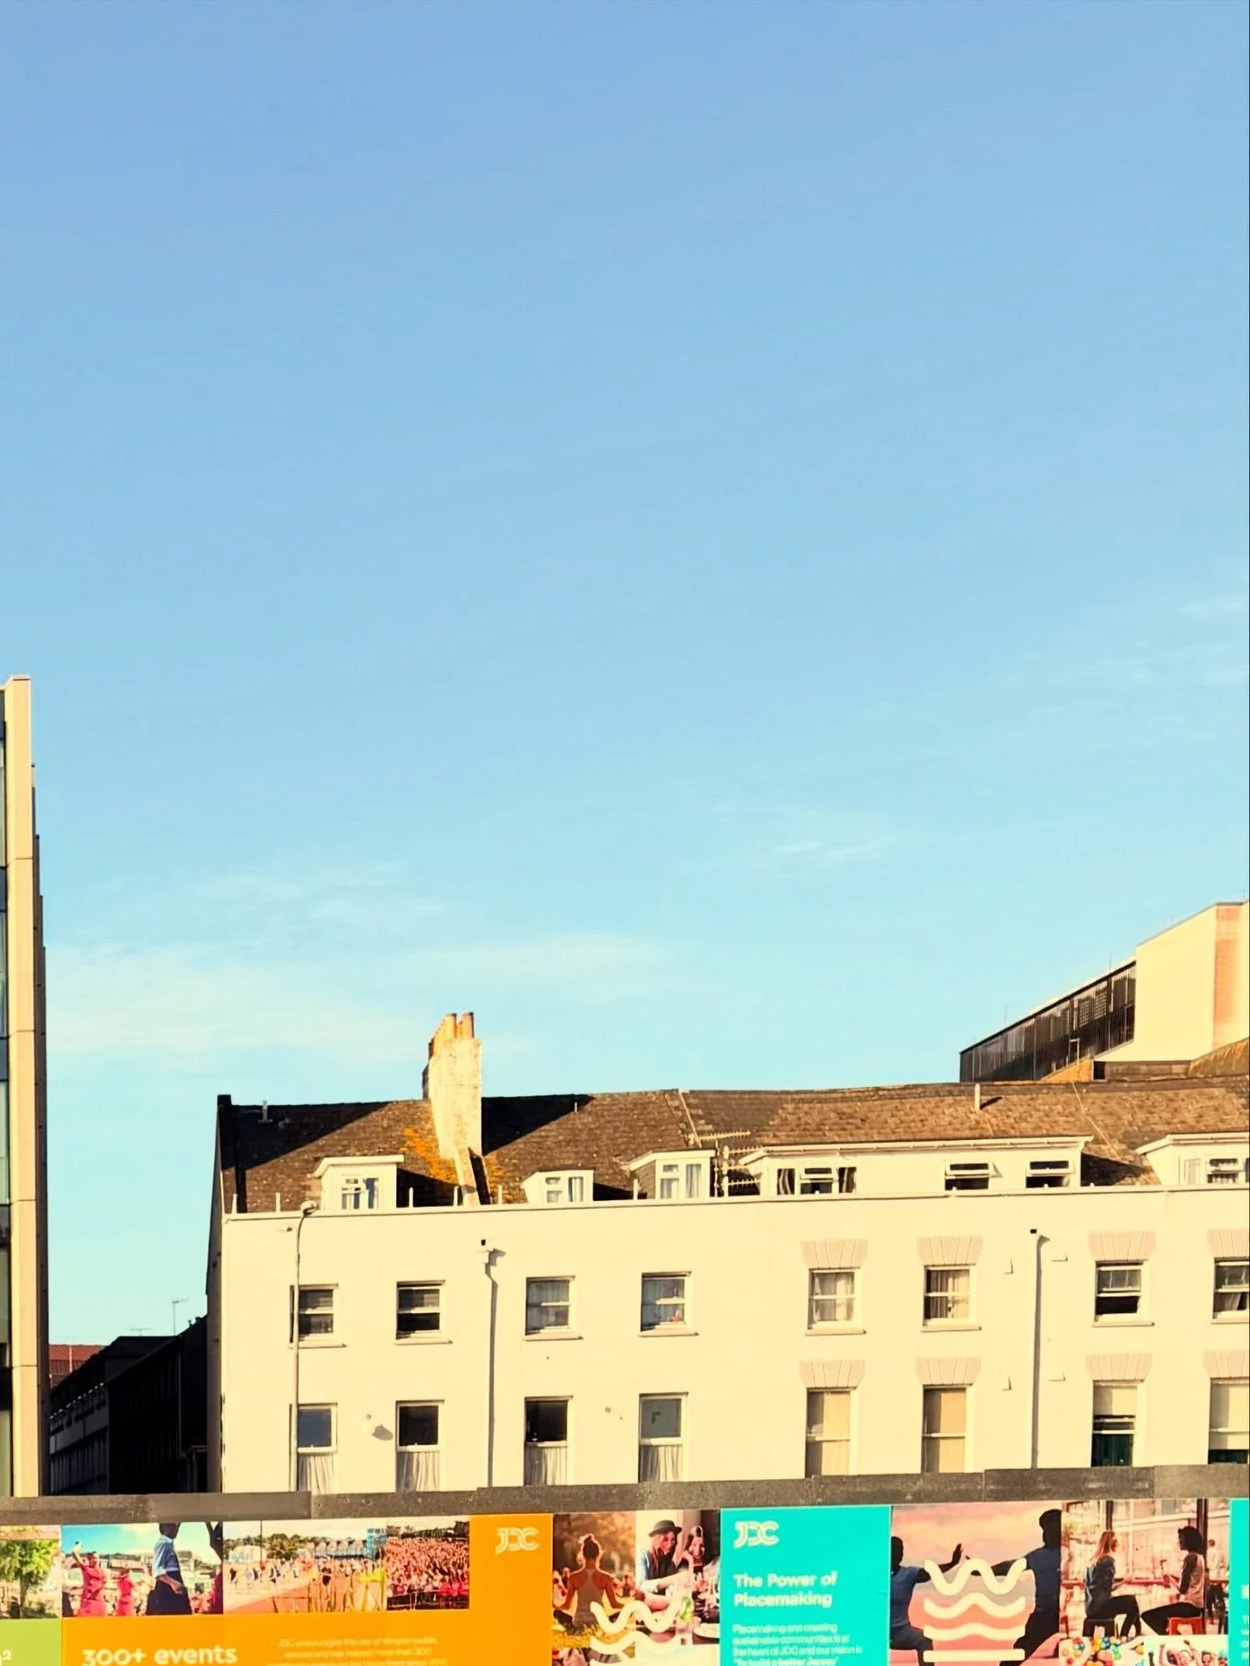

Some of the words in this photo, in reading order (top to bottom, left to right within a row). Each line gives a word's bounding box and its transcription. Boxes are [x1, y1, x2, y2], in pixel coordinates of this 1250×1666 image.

[494, 1526, 539, 1555] JDC
[733, 1520, 779, 1549] JDC
[733, 1573, 764, 1588] The
[767, 1573, 817, 1588] Power
[820, 1570, 839, 1586] of
[734, 1591, 833, 1608] Placemaking
[154, 1645, 238, 1665] events
